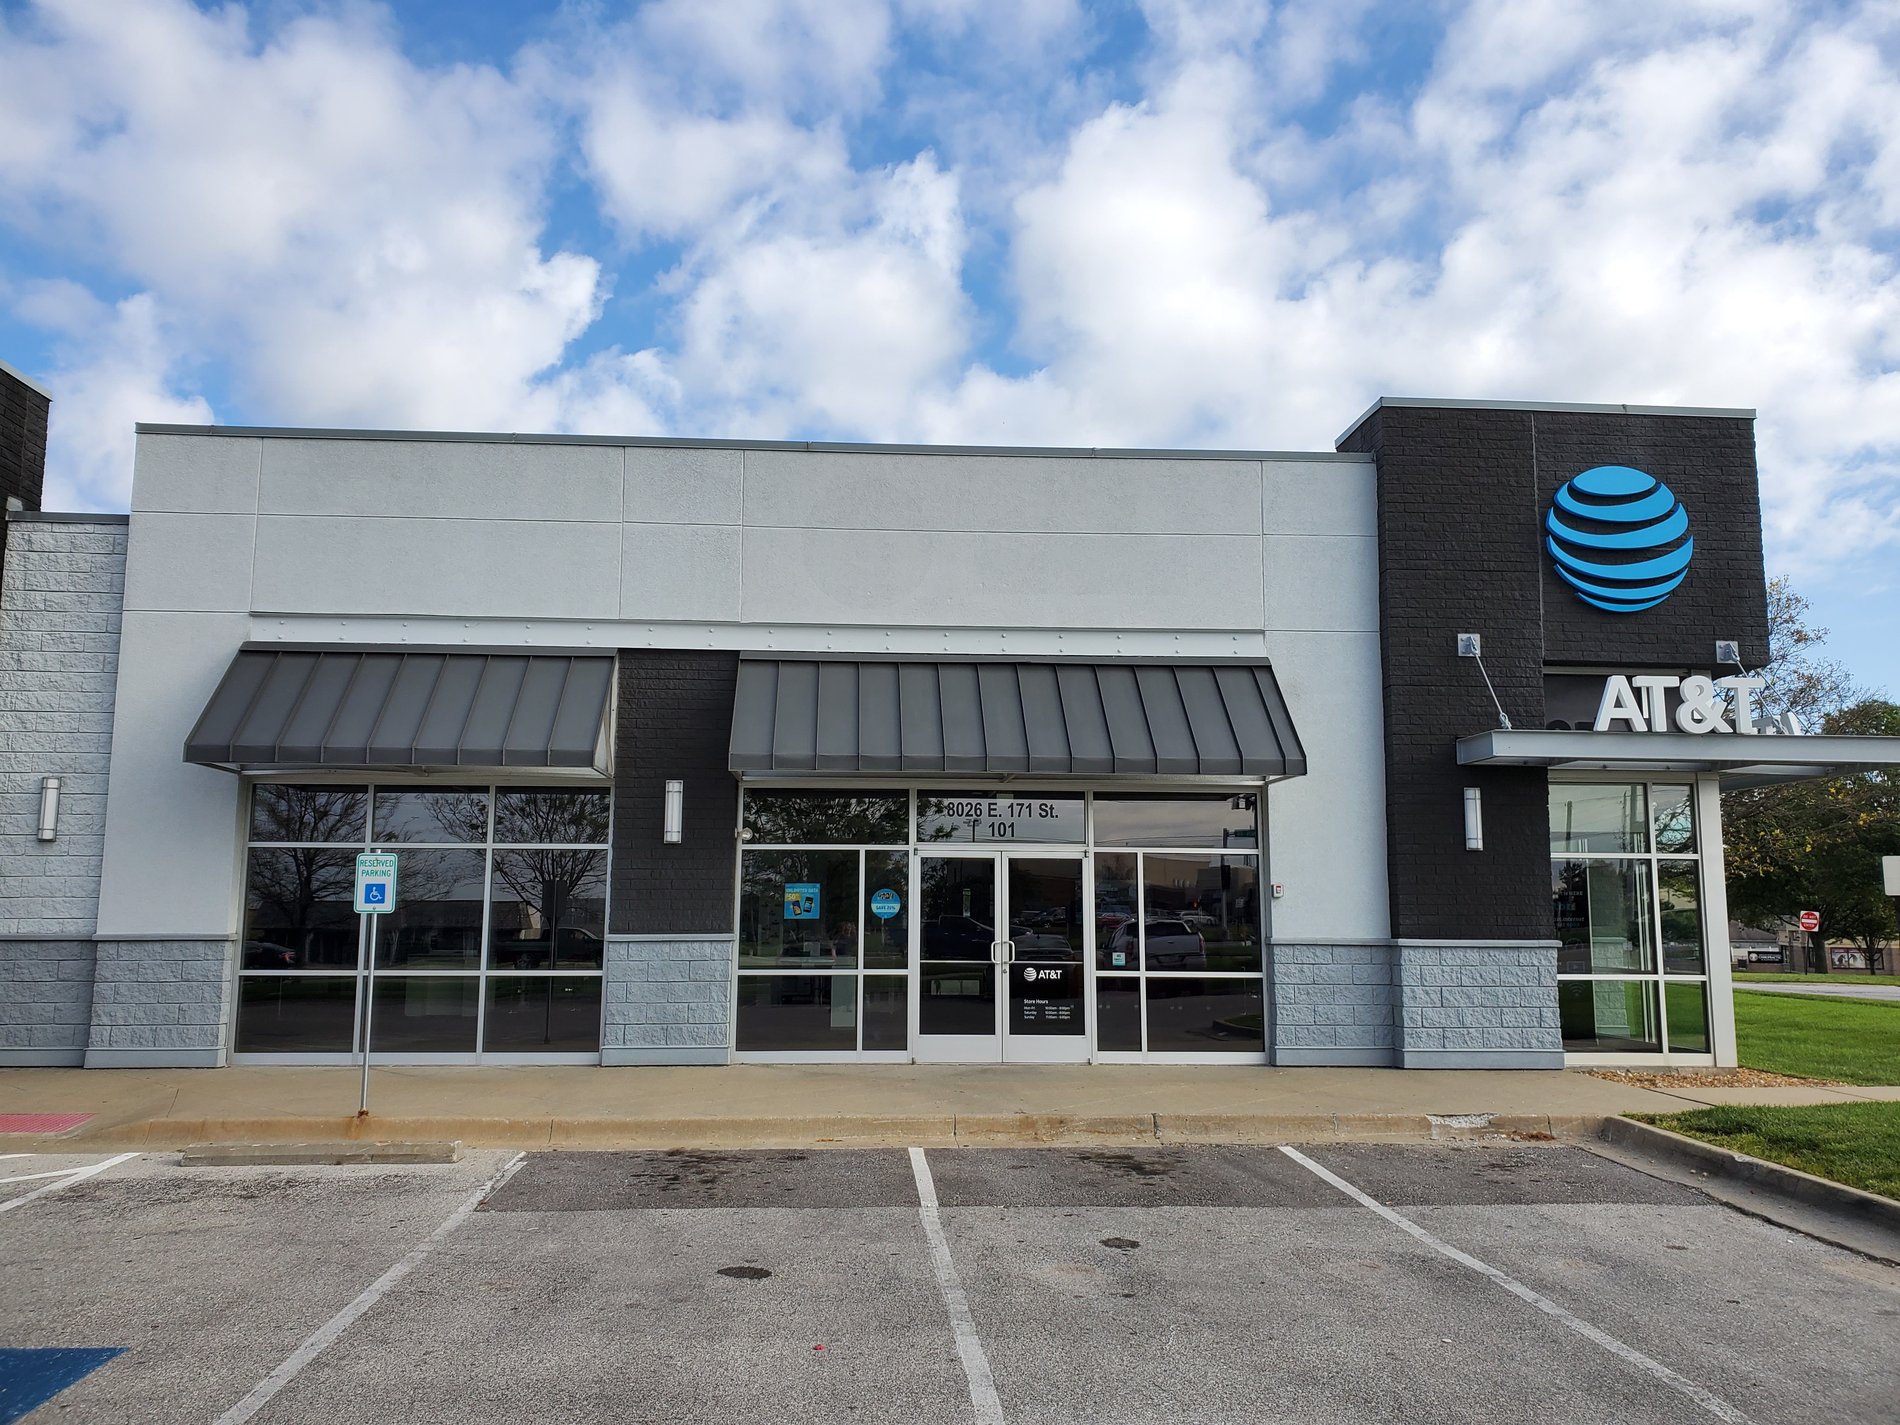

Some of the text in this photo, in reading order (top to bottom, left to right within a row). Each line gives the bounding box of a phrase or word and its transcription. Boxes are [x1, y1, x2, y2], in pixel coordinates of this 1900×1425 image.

[1593, 675, 1766, 734] AT&T
[947, 802, 1059, 818] 8026 E. 171 St.
[988, 822, 1015, 837] 101
[360, 859, 394, 867] RESERVED
[361, 869, 392, 877] PARKING
[1038, 970, 1062, 979] AT&T
